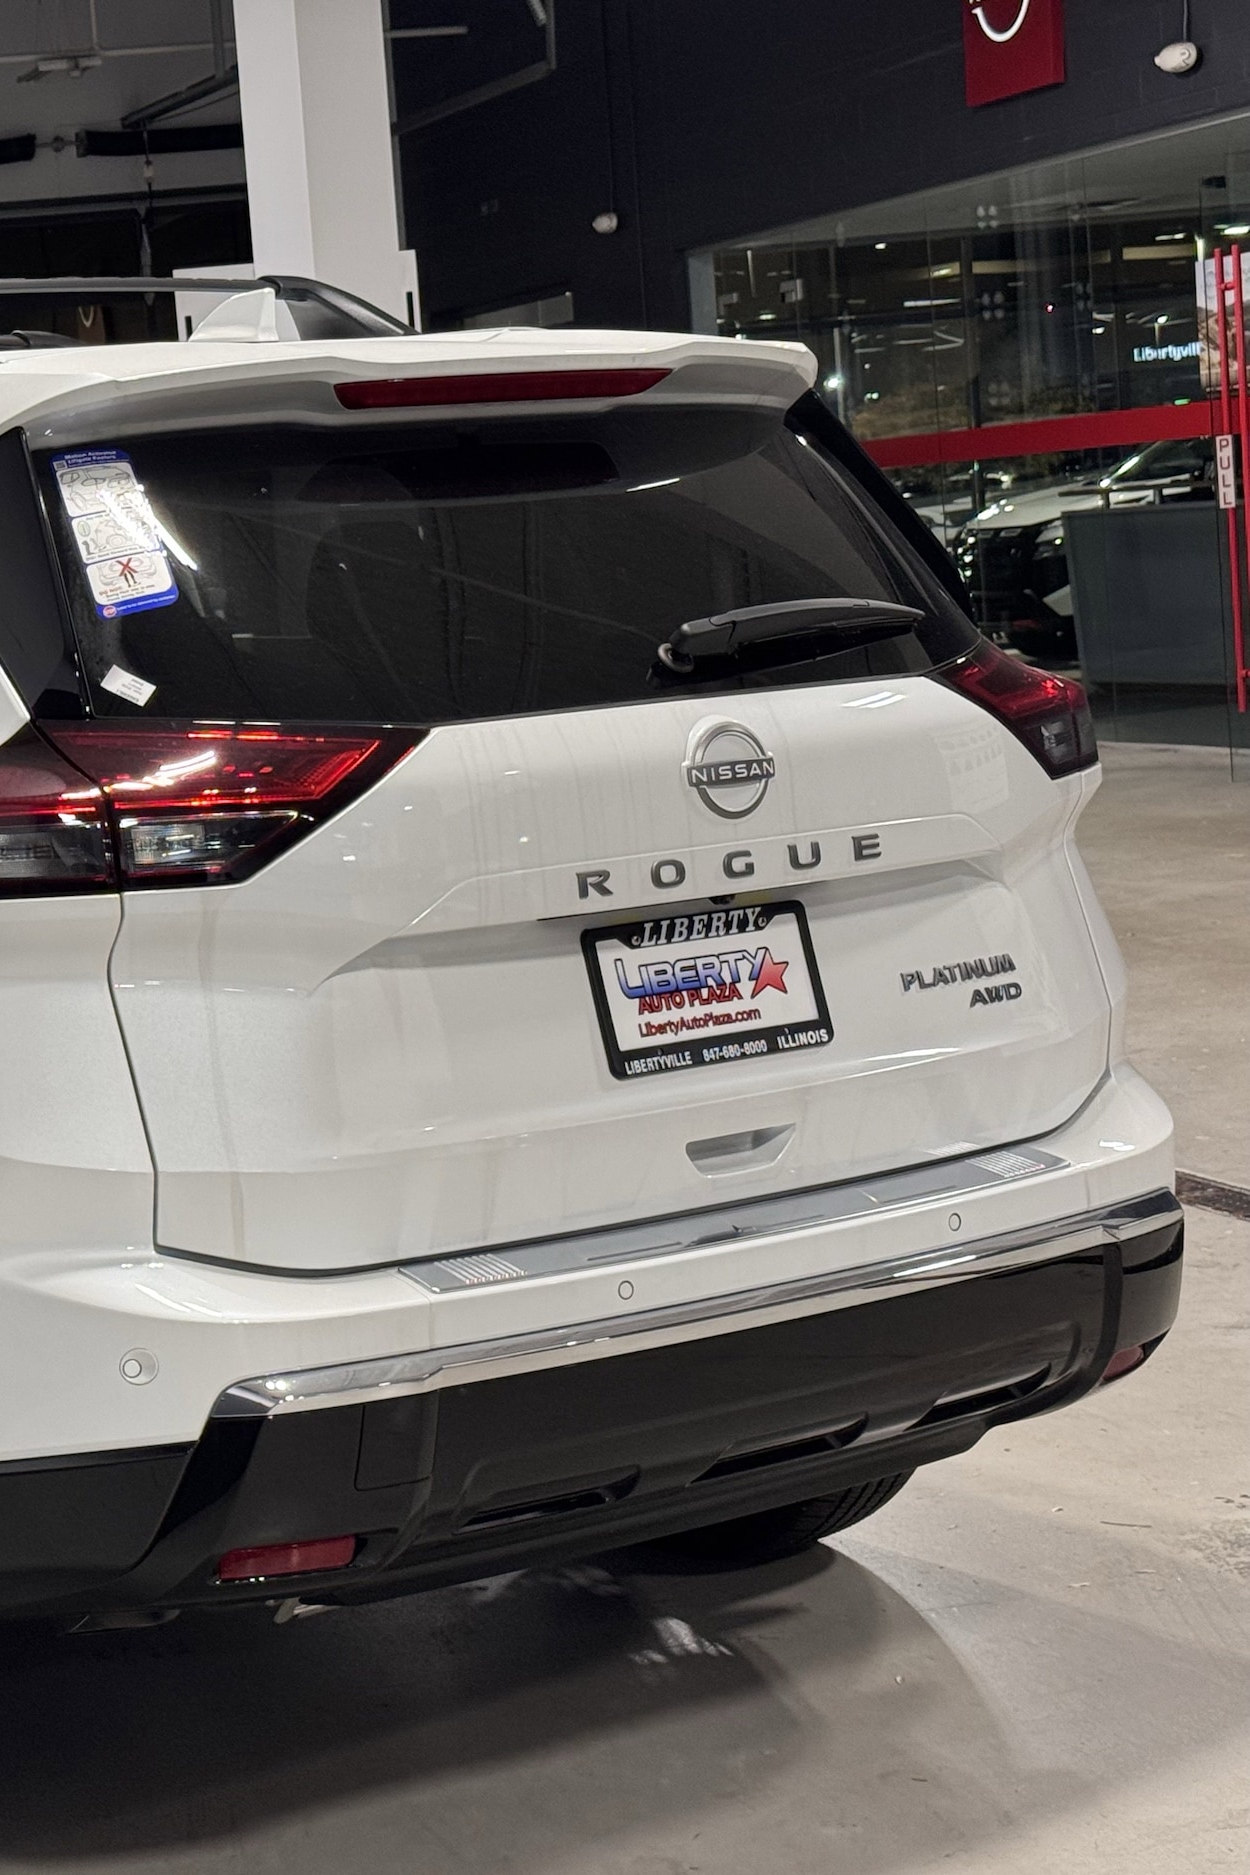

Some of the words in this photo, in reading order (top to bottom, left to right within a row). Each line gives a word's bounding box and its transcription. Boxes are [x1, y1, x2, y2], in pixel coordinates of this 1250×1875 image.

[1133, 341, 1201, 361] Libertyvill
[1218, 437, 1233, 506] PULL
[691, 760, 774, 783] NISSAN
[575, 833, 883, 900] ROGUE
[640, 907, 762, 947] LIBERTY
[614, 946, 770, 999] LIBERTY
[900, 953, 1017, 992] PLATINUM
[638, 990, 685, 1015] AUTO
[687, 983, 743, 1007] PLAZA
[969, 982, 1022, 1008] AWD
[638, 1008, 762, 1038] LibertyAutoPlaza.com
[624, 1051, 693, 1076] LIBERTYVILLE
[702, 1039, 768, 1062] 847-680-8000
[777, 1028, 829, 1050] ILLINOIS
